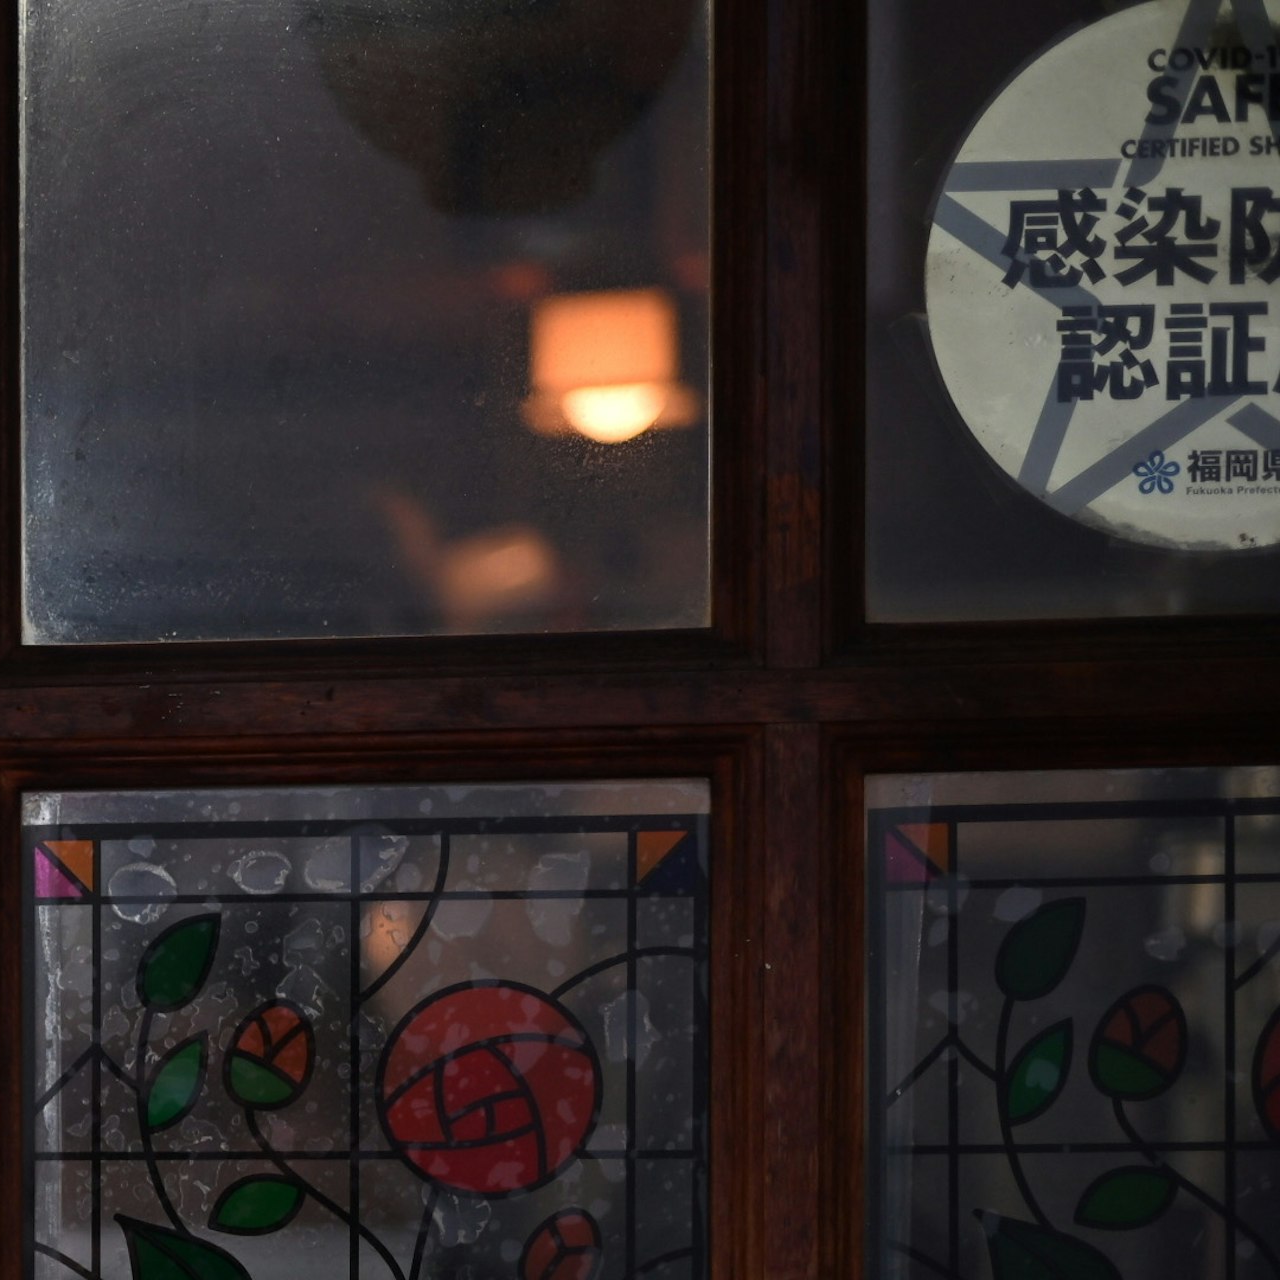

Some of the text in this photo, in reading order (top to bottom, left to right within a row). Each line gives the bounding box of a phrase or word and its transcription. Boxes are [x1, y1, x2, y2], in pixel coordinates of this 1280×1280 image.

[1148, 46, 1280, 72] COVID-1
[1120, 137, 1240, 159] CERTIFIED
[1057, 302, 1280, 403] 認証
[1186, 486, 1233, 495] Fukuoka
